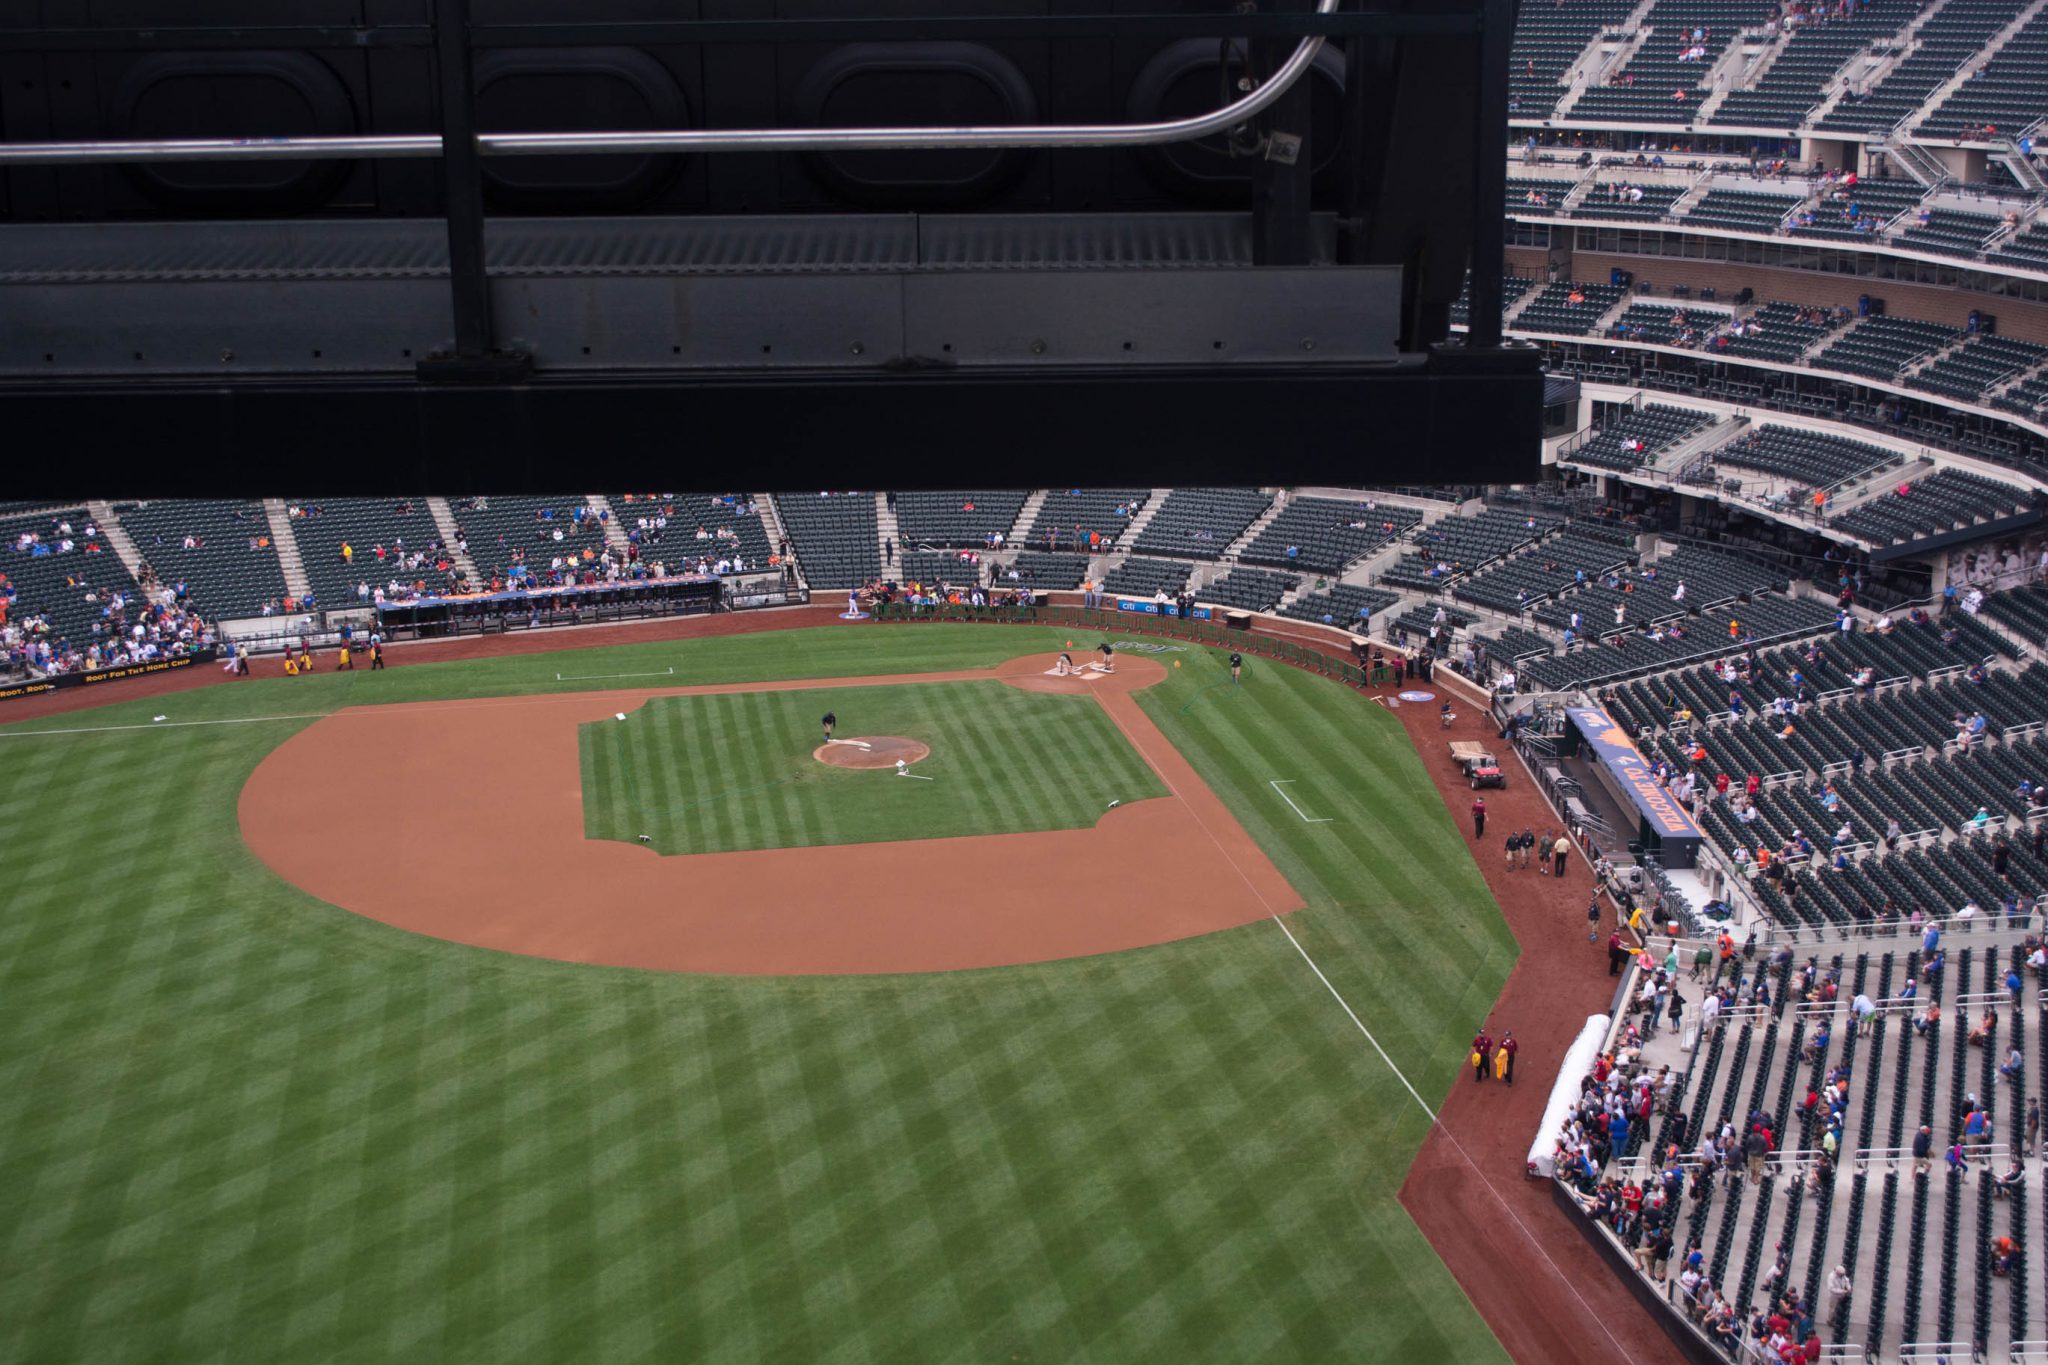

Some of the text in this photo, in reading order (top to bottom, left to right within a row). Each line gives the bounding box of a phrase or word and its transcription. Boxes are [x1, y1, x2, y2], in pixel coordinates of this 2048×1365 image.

[1122, 602, 1136, 611] citi
[1145, 605, 1158, 613] citi
[1193, 610, 1205, 618] citi
[86, 674, 107, 682] ROOT
[1623, 767, 1689, 832] WELCOME TO
